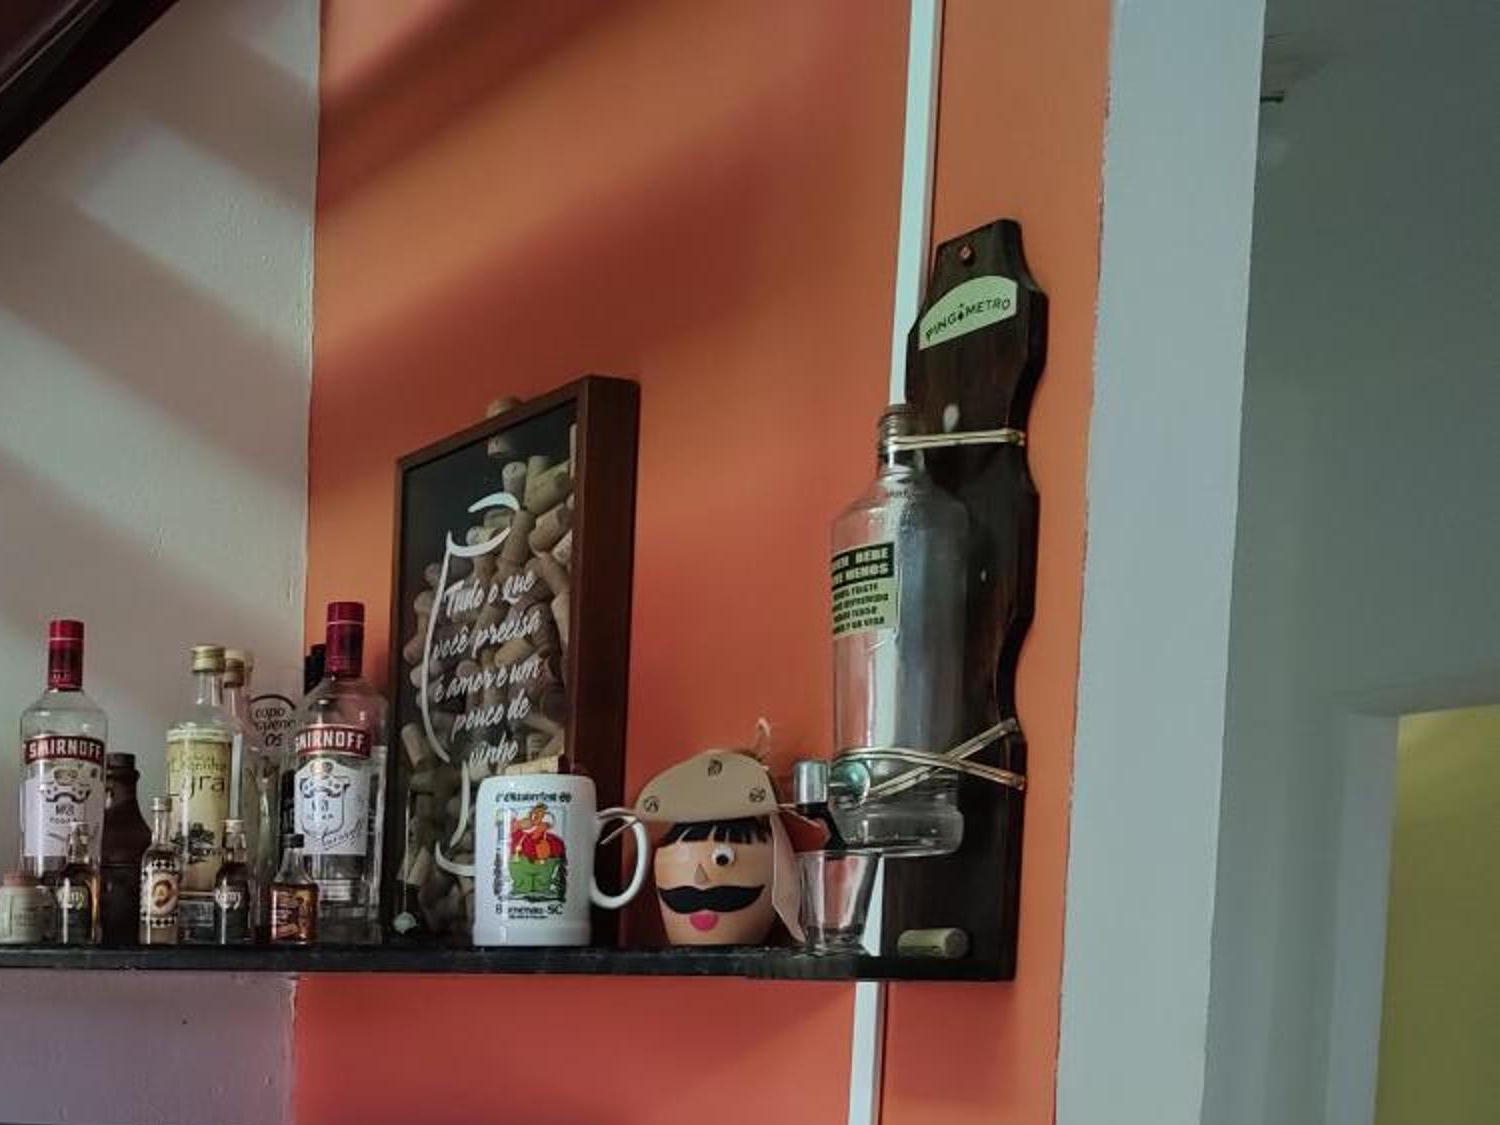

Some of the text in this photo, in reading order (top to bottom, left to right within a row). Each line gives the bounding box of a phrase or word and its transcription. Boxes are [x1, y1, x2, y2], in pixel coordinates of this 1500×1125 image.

[444, 579, 485, 617] Tudo
[433, 610, 541, 660] você precisa
[447, 668, 494, 699] amor
[508, 653, 542, 684] um
[452, 687, 531, 742] pouco de
[29, 739, 101, 760] SMIRNOFF
[468, 732, 519, 766] vinho
